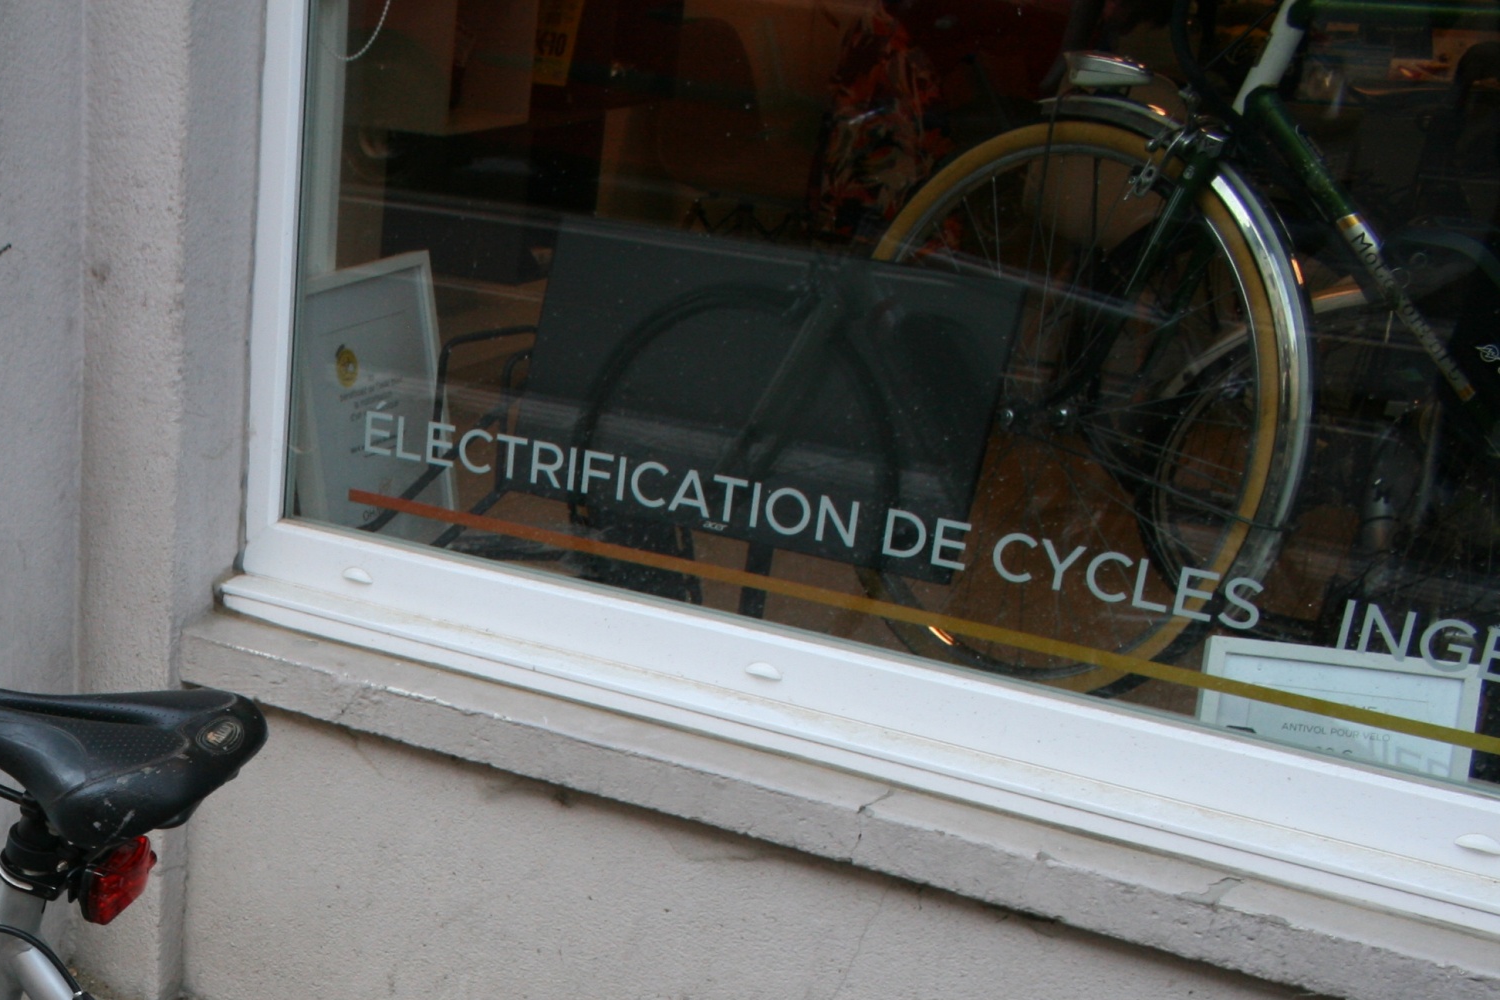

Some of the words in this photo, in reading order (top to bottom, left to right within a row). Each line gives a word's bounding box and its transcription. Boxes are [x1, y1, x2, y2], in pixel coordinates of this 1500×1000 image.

[364, 401, 861, 548] ÉLECTRIFICATION
[881, 508, 972, 571] DE
[992, 532, 1265, 630] CYCLES
[1336, 599, 1500, 683] INGE
[1281, 721, 1327, 735] ANTIVOL
[1330, 727, 1360, 740] POUR
